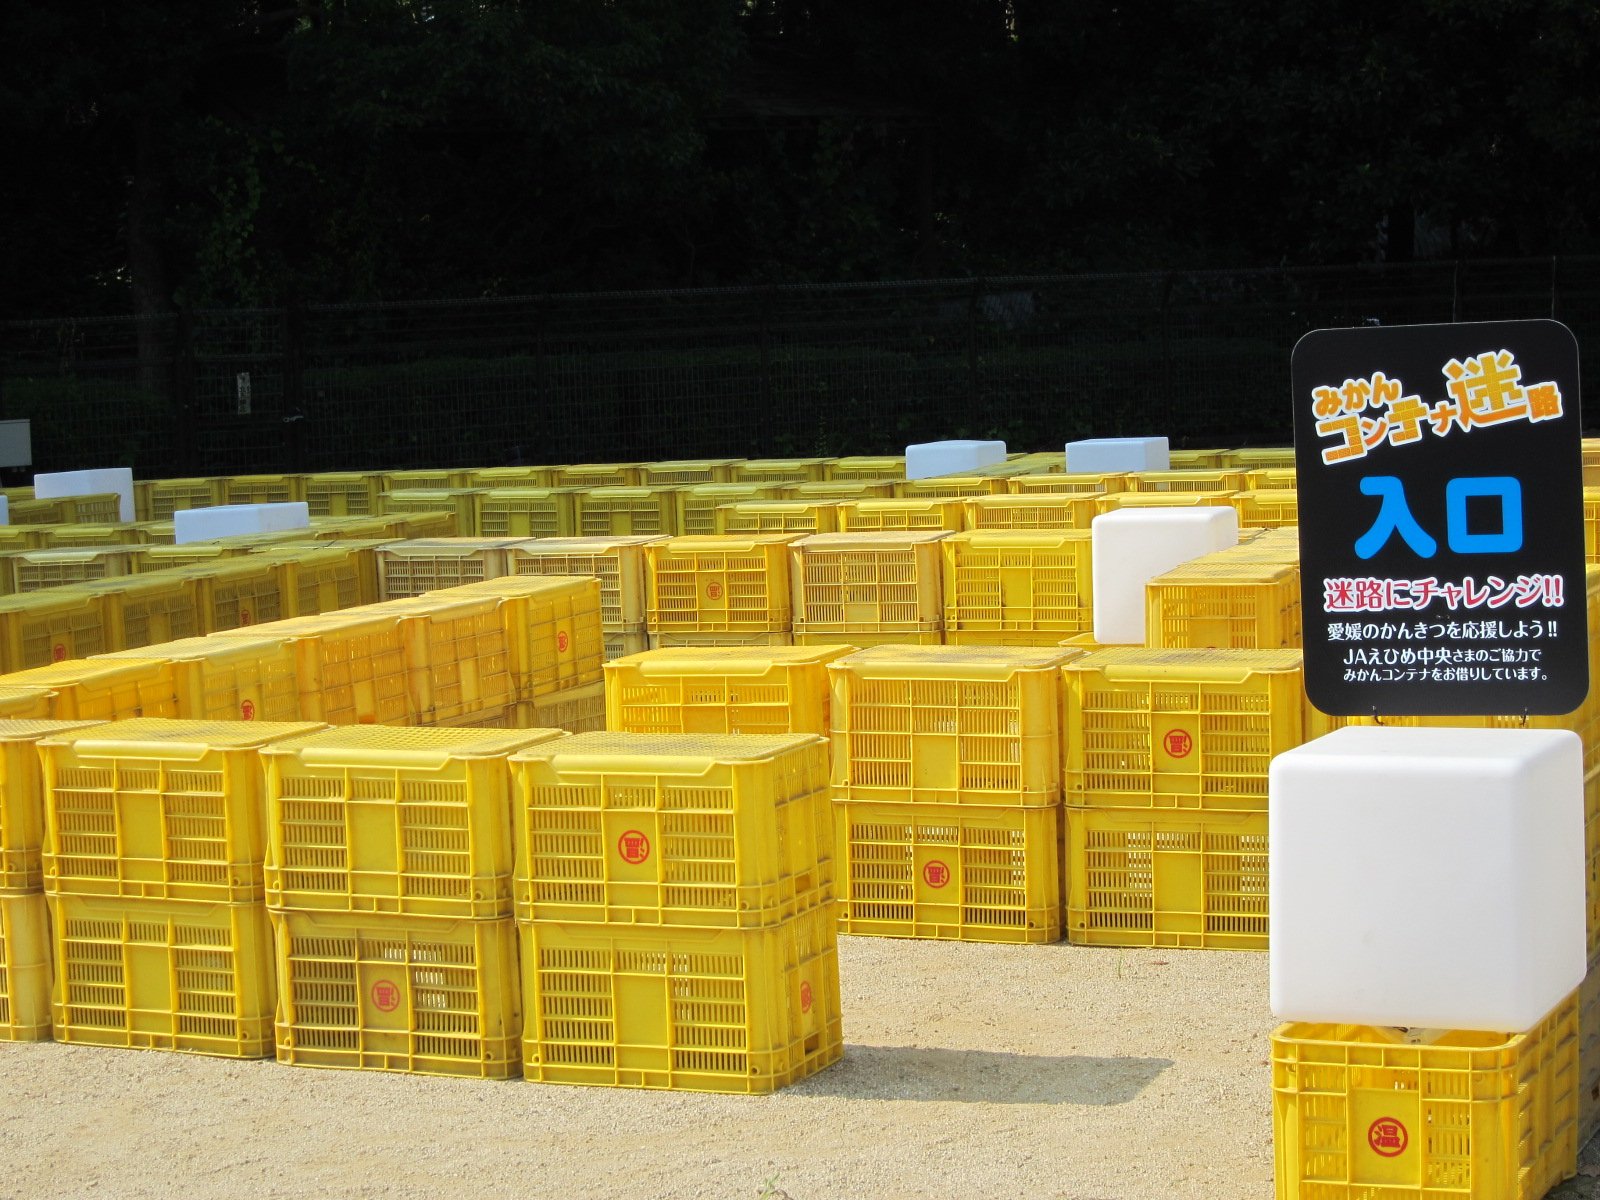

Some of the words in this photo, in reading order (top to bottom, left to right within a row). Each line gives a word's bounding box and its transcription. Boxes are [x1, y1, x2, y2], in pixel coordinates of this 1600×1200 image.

[1312, 371, 1402, 418] みかん
[1315, 349, 1563, 465] コンテナ迷路
[1354, 475, 1523, 559] 入口
[1343, 647, 1542, 665] JAえひめ中央さまのご協力で
